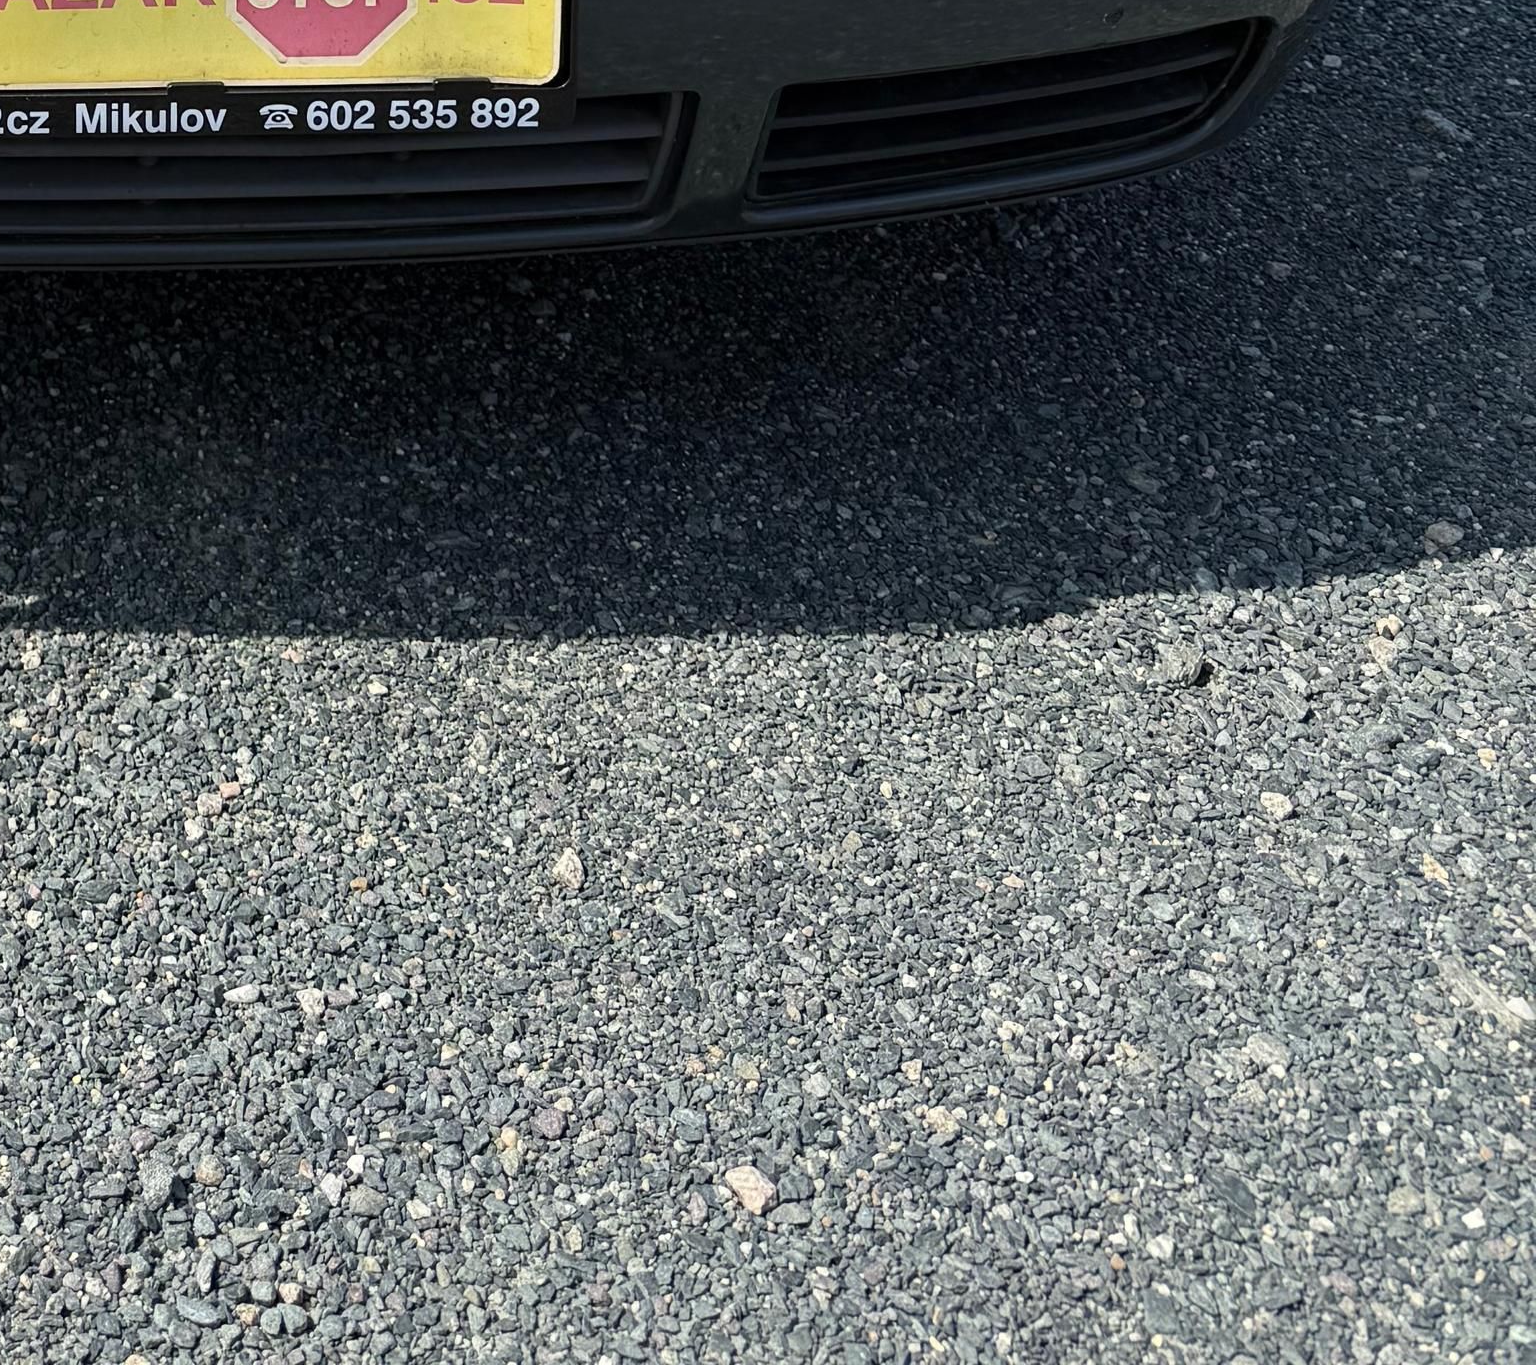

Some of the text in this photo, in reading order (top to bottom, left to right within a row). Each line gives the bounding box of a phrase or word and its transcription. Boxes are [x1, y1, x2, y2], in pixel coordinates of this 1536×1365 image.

[74, 102, 228, 136] Mikulov
[306, 99, 376, 132] 602
[387, 98, 458, 131] 535
[470, 95, 541, 129] 892
